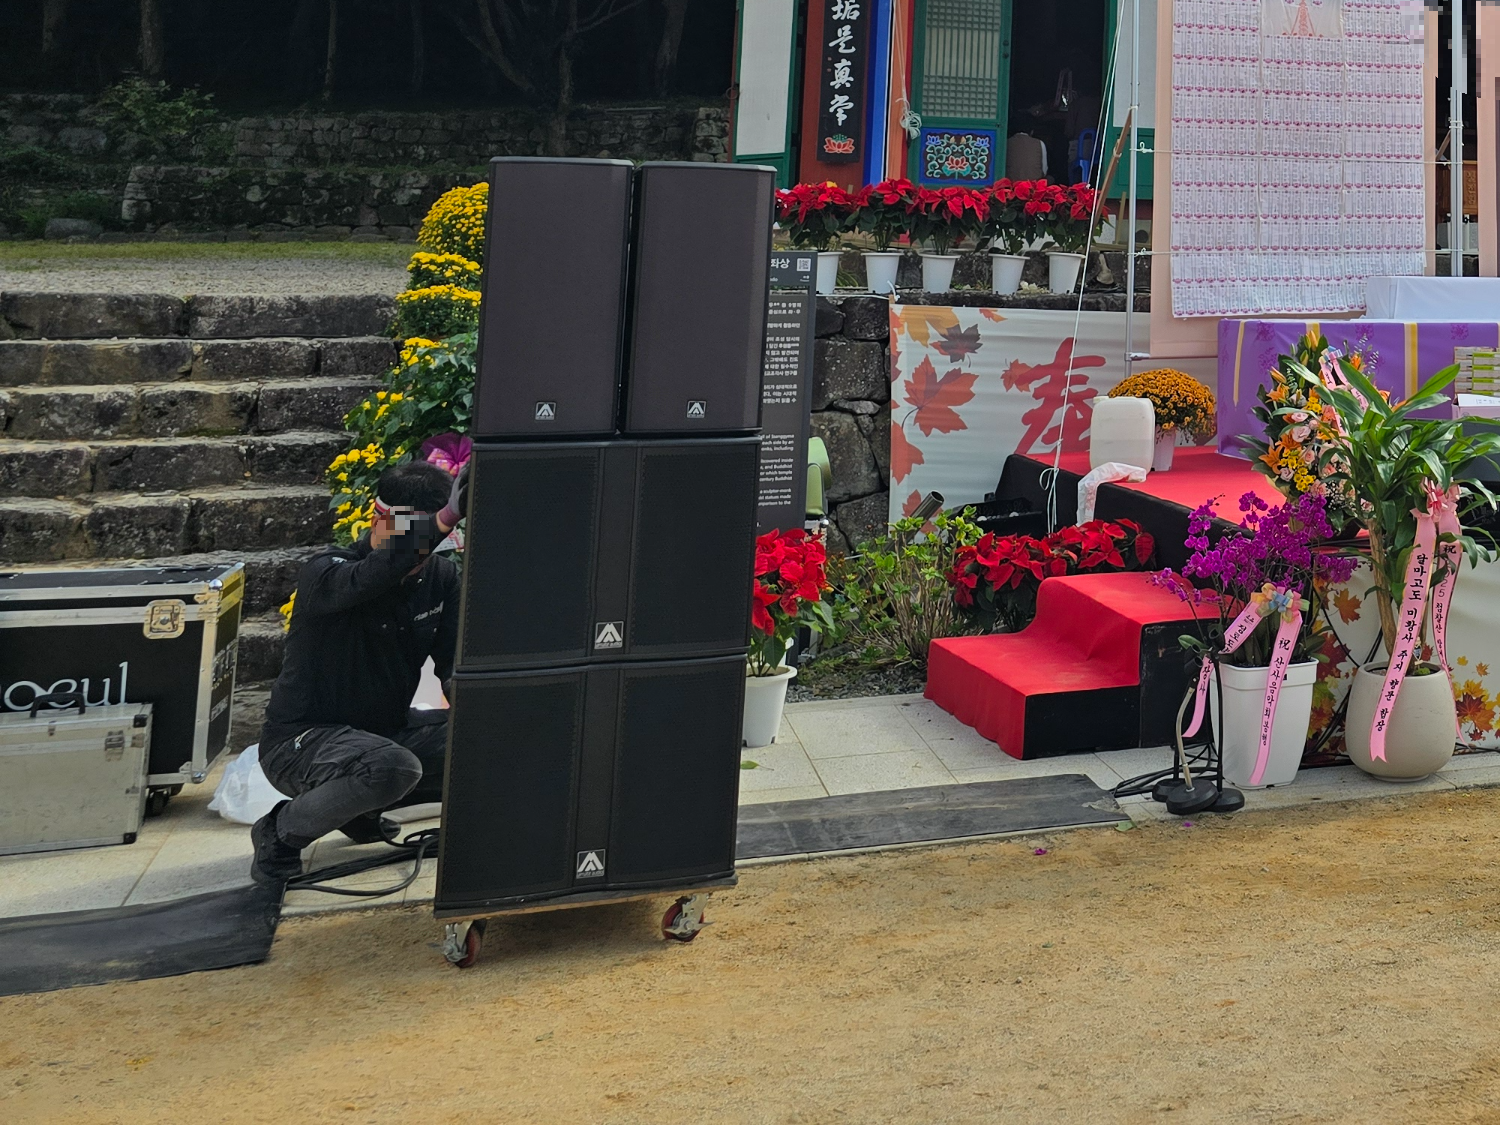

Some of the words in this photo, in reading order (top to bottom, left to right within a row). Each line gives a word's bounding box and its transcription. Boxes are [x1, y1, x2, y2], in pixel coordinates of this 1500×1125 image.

[1408, 553, 1429, 601] 달마고도
[1392, 649, 1408, 672] 주지
[0, 661, 129, 711] oeul
[1375, 707, 1390, 732] 합장
